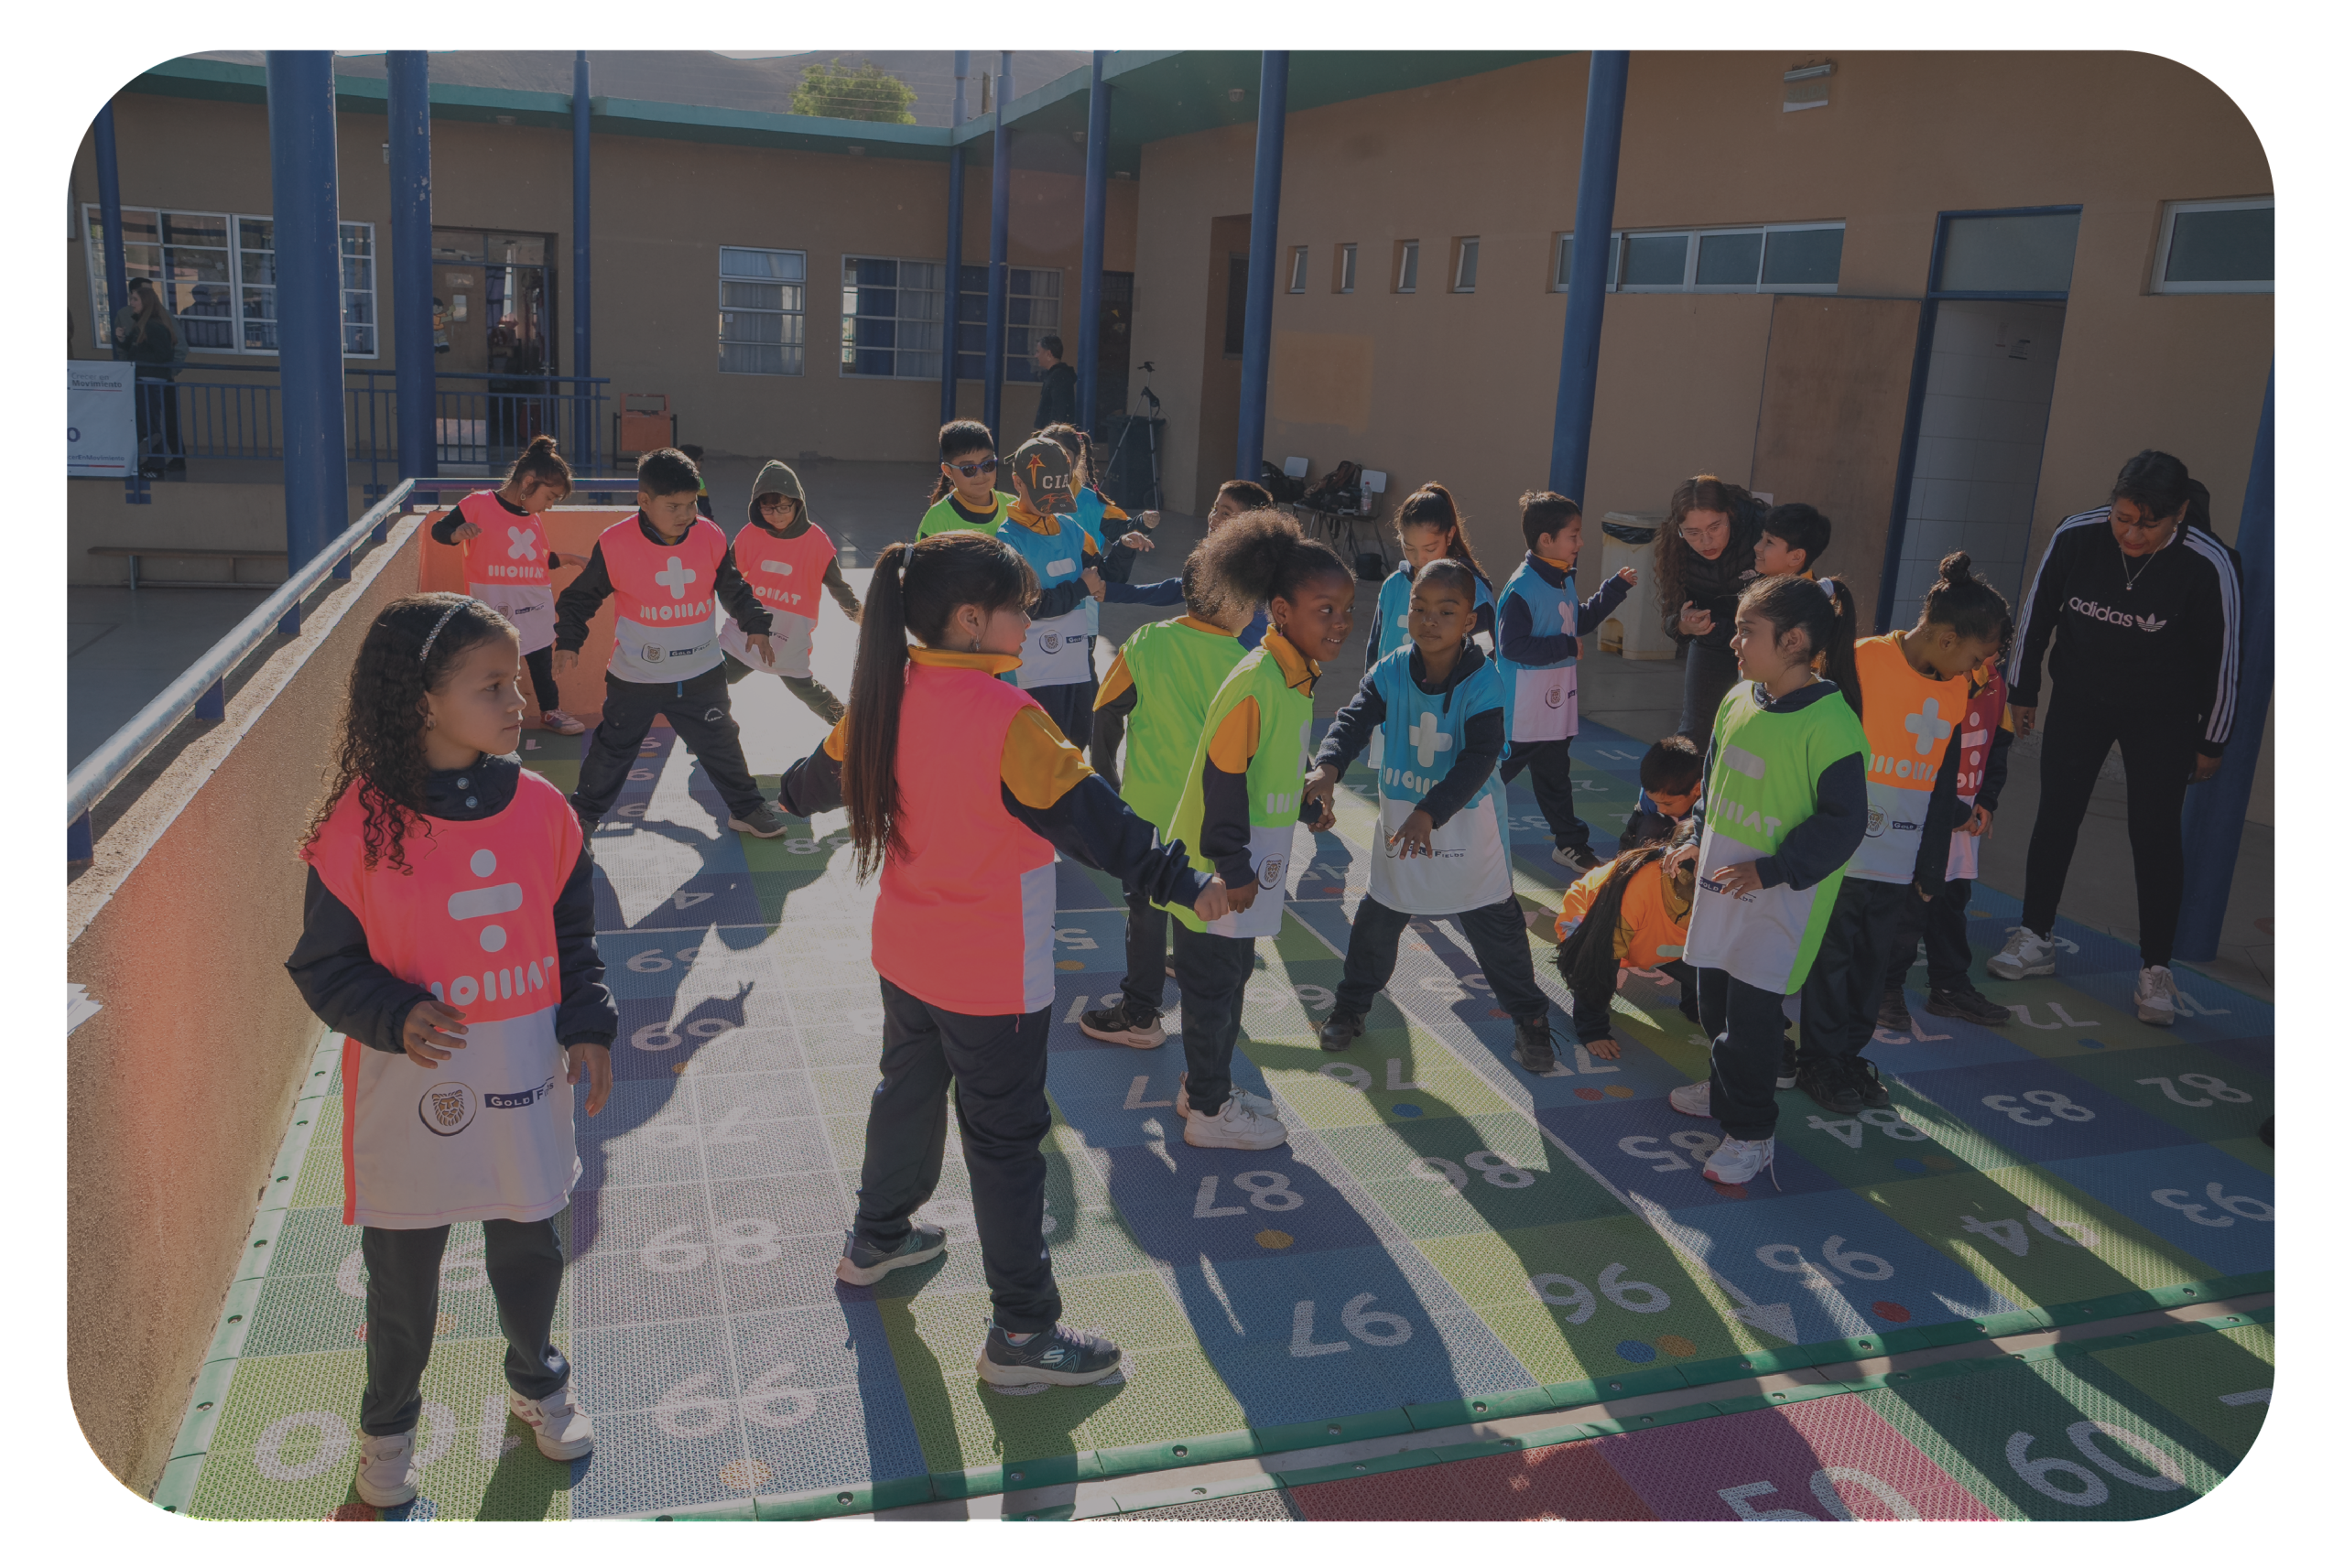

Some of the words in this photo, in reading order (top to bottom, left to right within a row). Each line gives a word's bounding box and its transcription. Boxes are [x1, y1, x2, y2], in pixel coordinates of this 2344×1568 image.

[1786, 83, 1828, 102] SALIDA
[71, 380, 123, 388] Movimiento
[1042, 473, 1070, 489] CIA
[2068, 597, 2133, 627] adidas
[1893, 821, 1915, 830] GOLD
[2005, 1001, 2102, 1030] 72
[488, 1094, 532, 1108] GOLD
[1981, 1090, 2096, 1127] 83
[2133, 1073, 2253, 1108] 82
[1806, 1108, 1927, 1150] 84
[1618, 1130, 1720, 1173] 85
[1193, 1170, 1305, 1218] 87
[1407, 1150, 1536, 1196] 86
[2151, 1182, 2275, 1227] 93
[1959, 1206, 2100, 1258] 94
[1756, 1234, 1895, 1292] 95
[1526, 1261, 1672, 1325] 96
[1289, 1291, 1413, 1358] 97
[2005, 1419, 2187, 1508] 60
